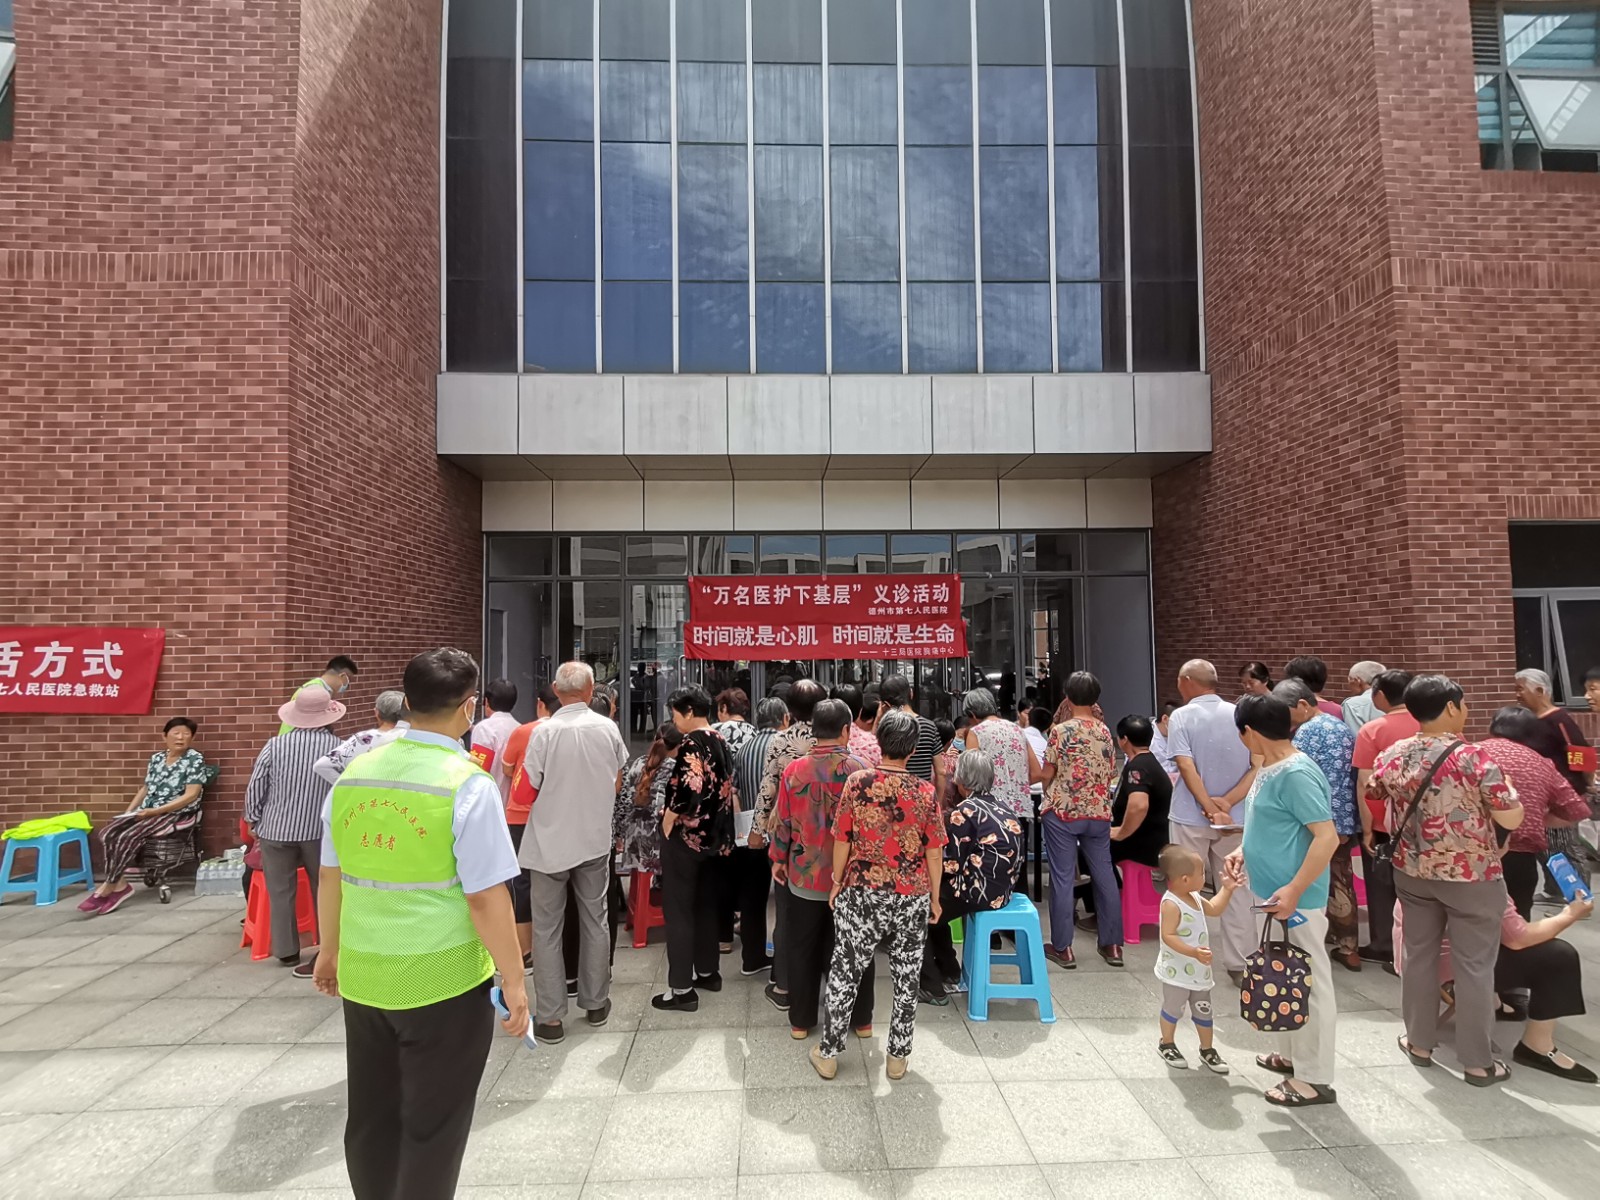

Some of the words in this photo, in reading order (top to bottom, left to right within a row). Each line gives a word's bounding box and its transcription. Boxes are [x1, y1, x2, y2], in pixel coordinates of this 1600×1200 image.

[702, 583, 862, 606] “万名医护下基层”
[873, 582, 950, 605] 义诊活动
[868, 606, 949, 616] 德州市第七人民医院
[693, 626, 819, 647] 时间就是心肌
[833, 623, 955, 646] 时间就是生命
[360, 832, 396, 851] 志愿者
